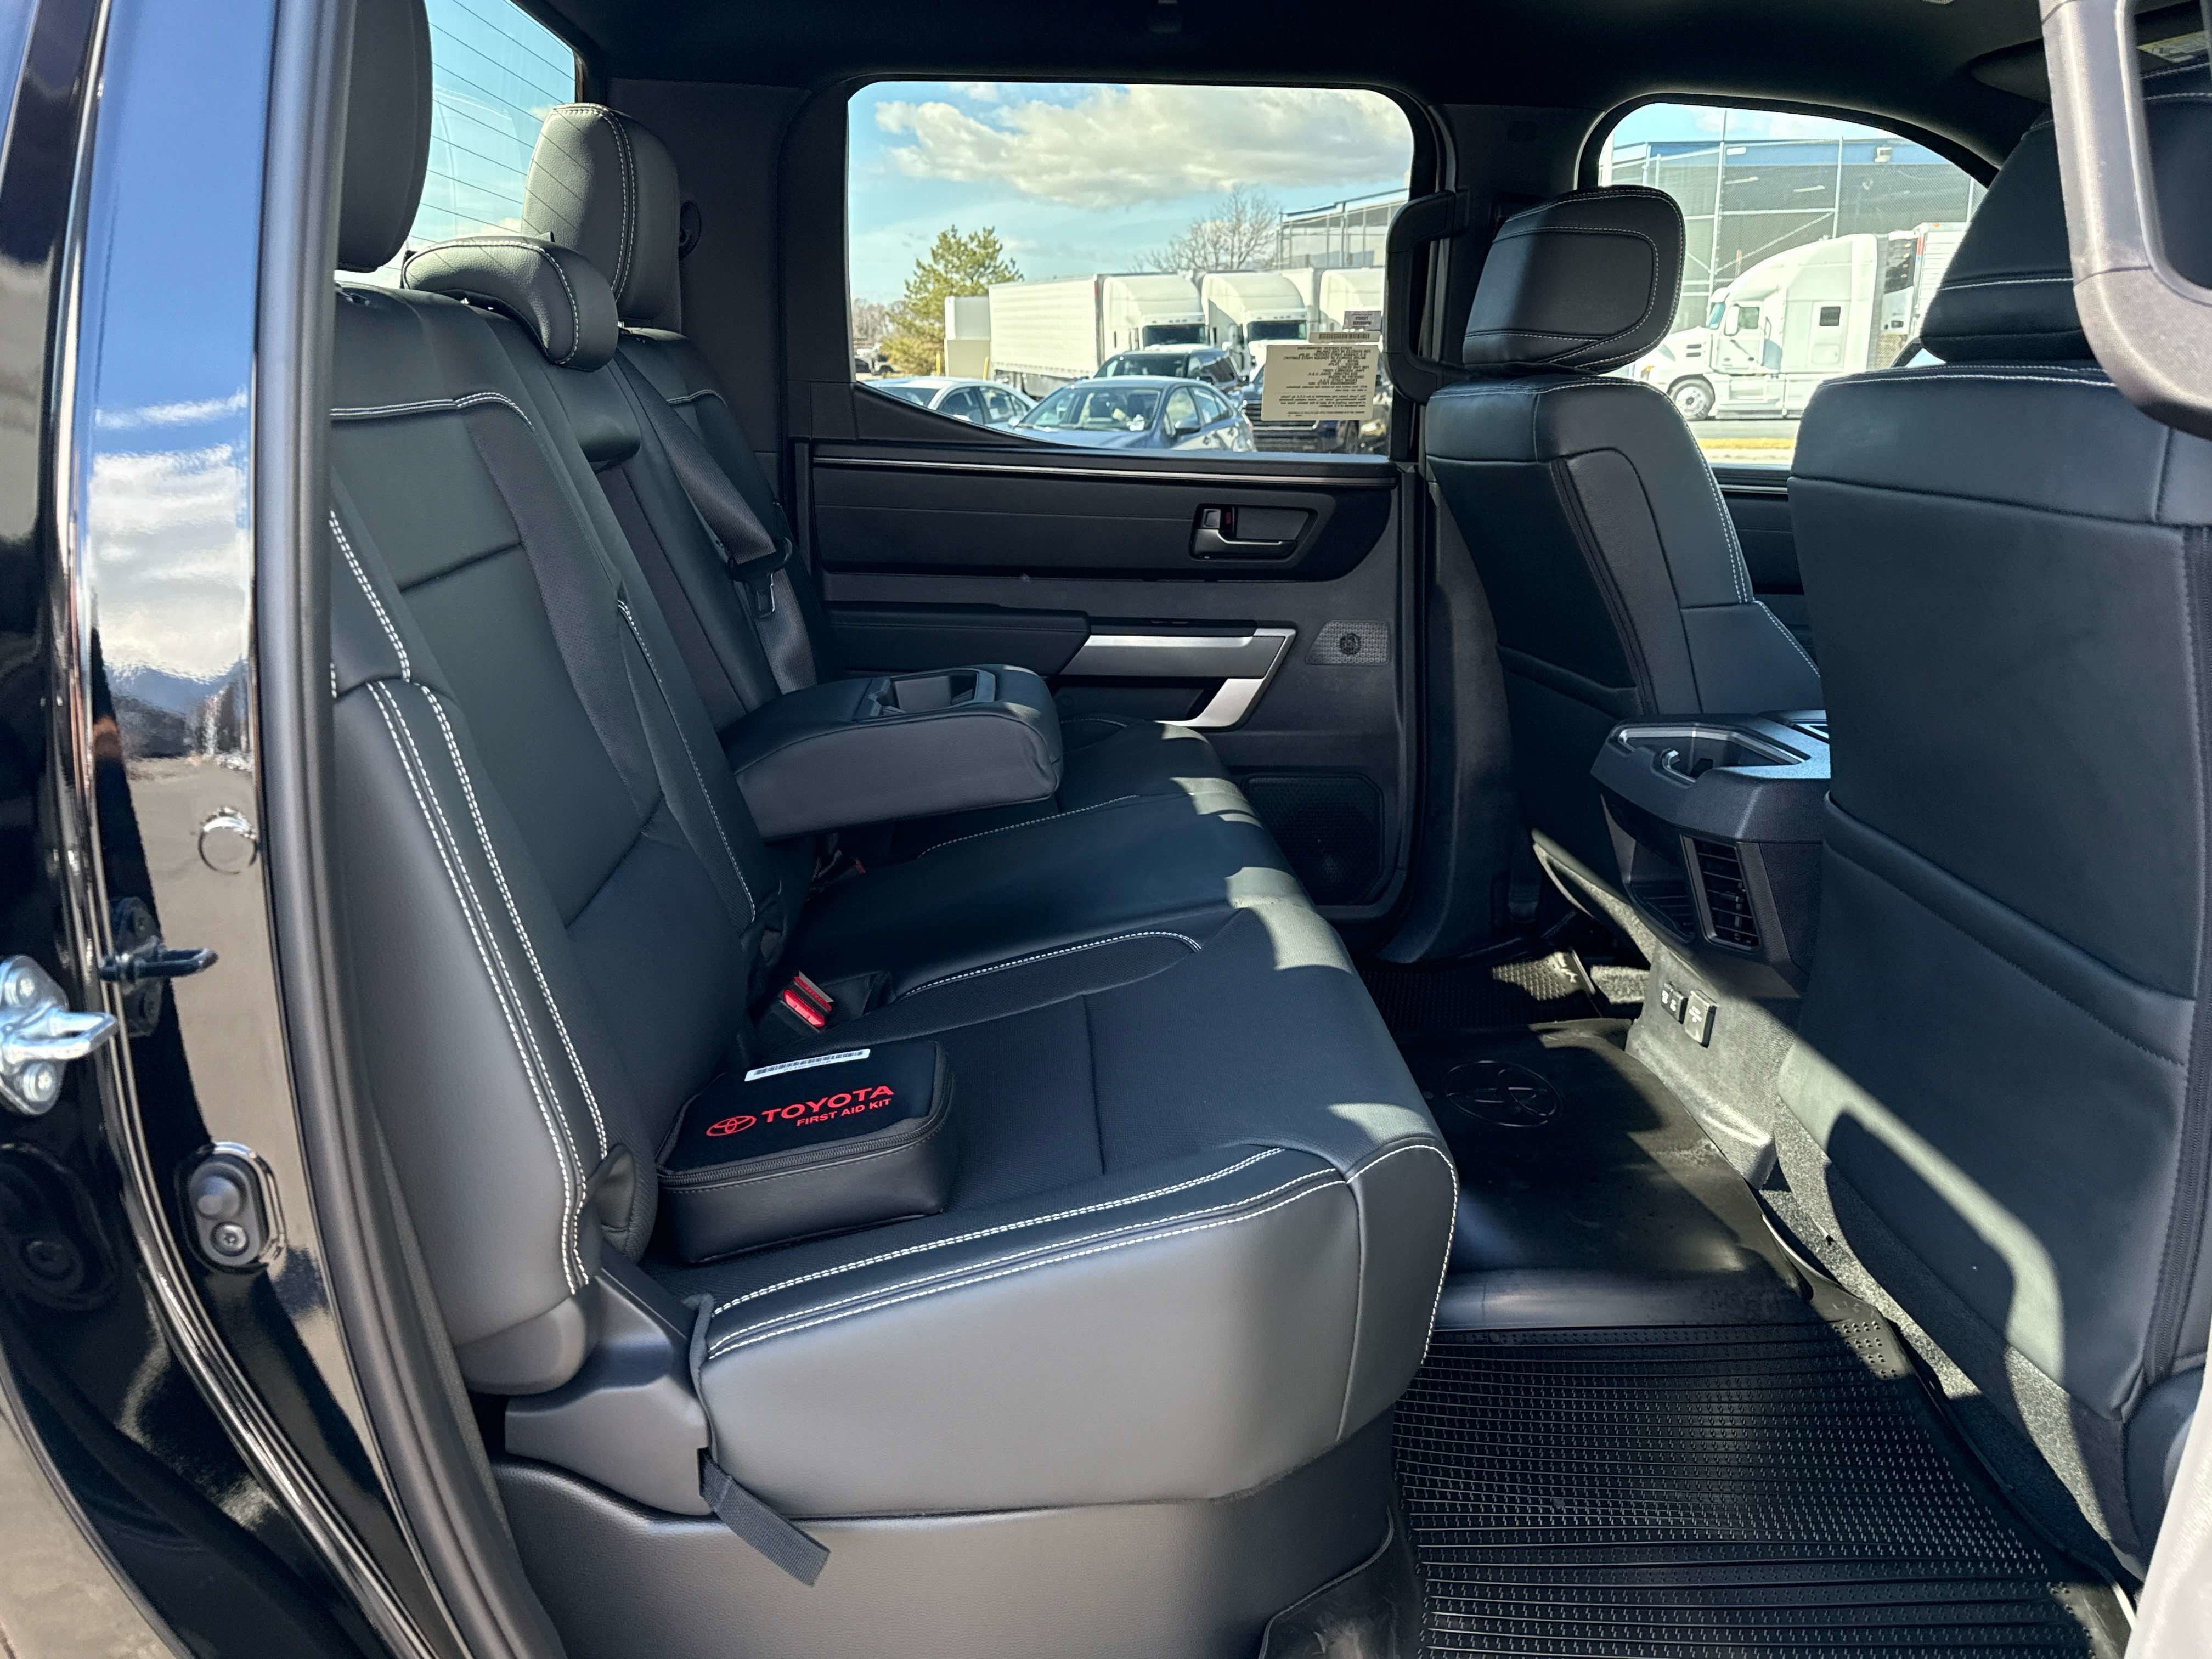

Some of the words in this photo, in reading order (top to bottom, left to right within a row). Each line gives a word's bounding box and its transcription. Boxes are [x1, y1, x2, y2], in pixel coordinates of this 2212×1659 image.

[761, 1086, 894, 1123] TOYOTA
[797, 1111, 837, 1126] FIRST
[841, 1104, 865, 1116] AID
[869, 1098, 891, 1110] KIT
